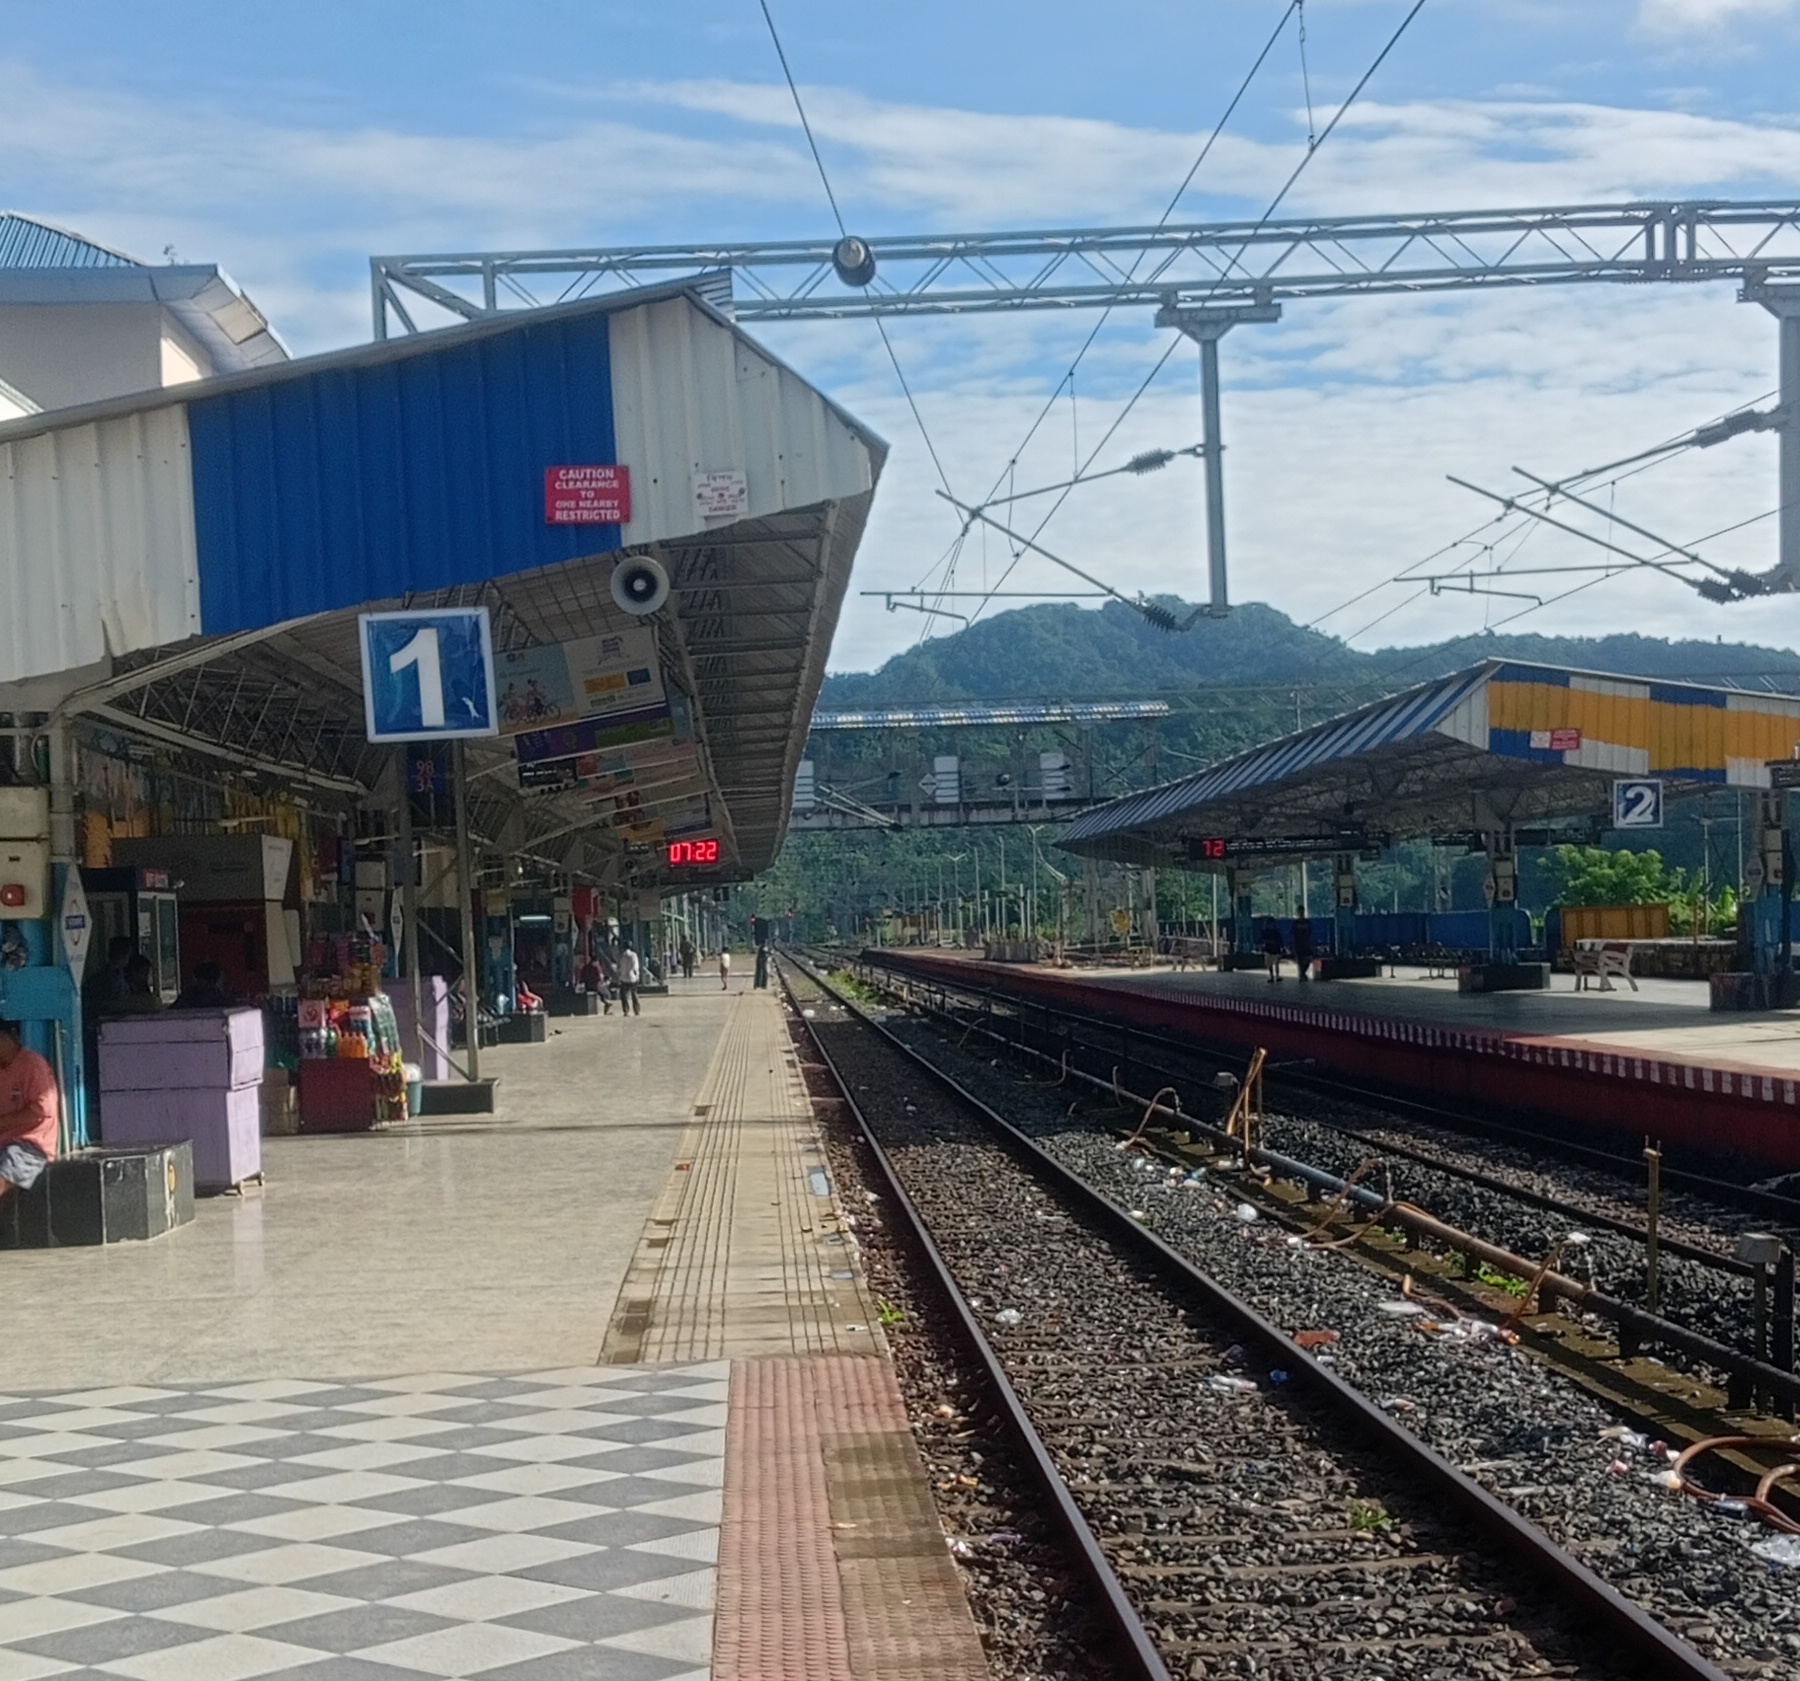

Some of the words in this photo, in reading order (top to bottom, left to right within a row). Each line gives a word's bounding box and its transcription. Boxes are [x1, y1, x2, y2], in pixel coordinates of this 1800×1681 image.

[558, 469, 615, 480] CAUTION
[554, 480, 620, 490] CLEARANCE
[579, 490, 596, 499] TO
[578, 499, 619, 509] NEARBY
[555, 509, 621, 521] RESTRICTED
[389, 627, 446, 729] 1
[1623, 785, 1654, 823] 2
[670, 841, 717, 863] 07:22
